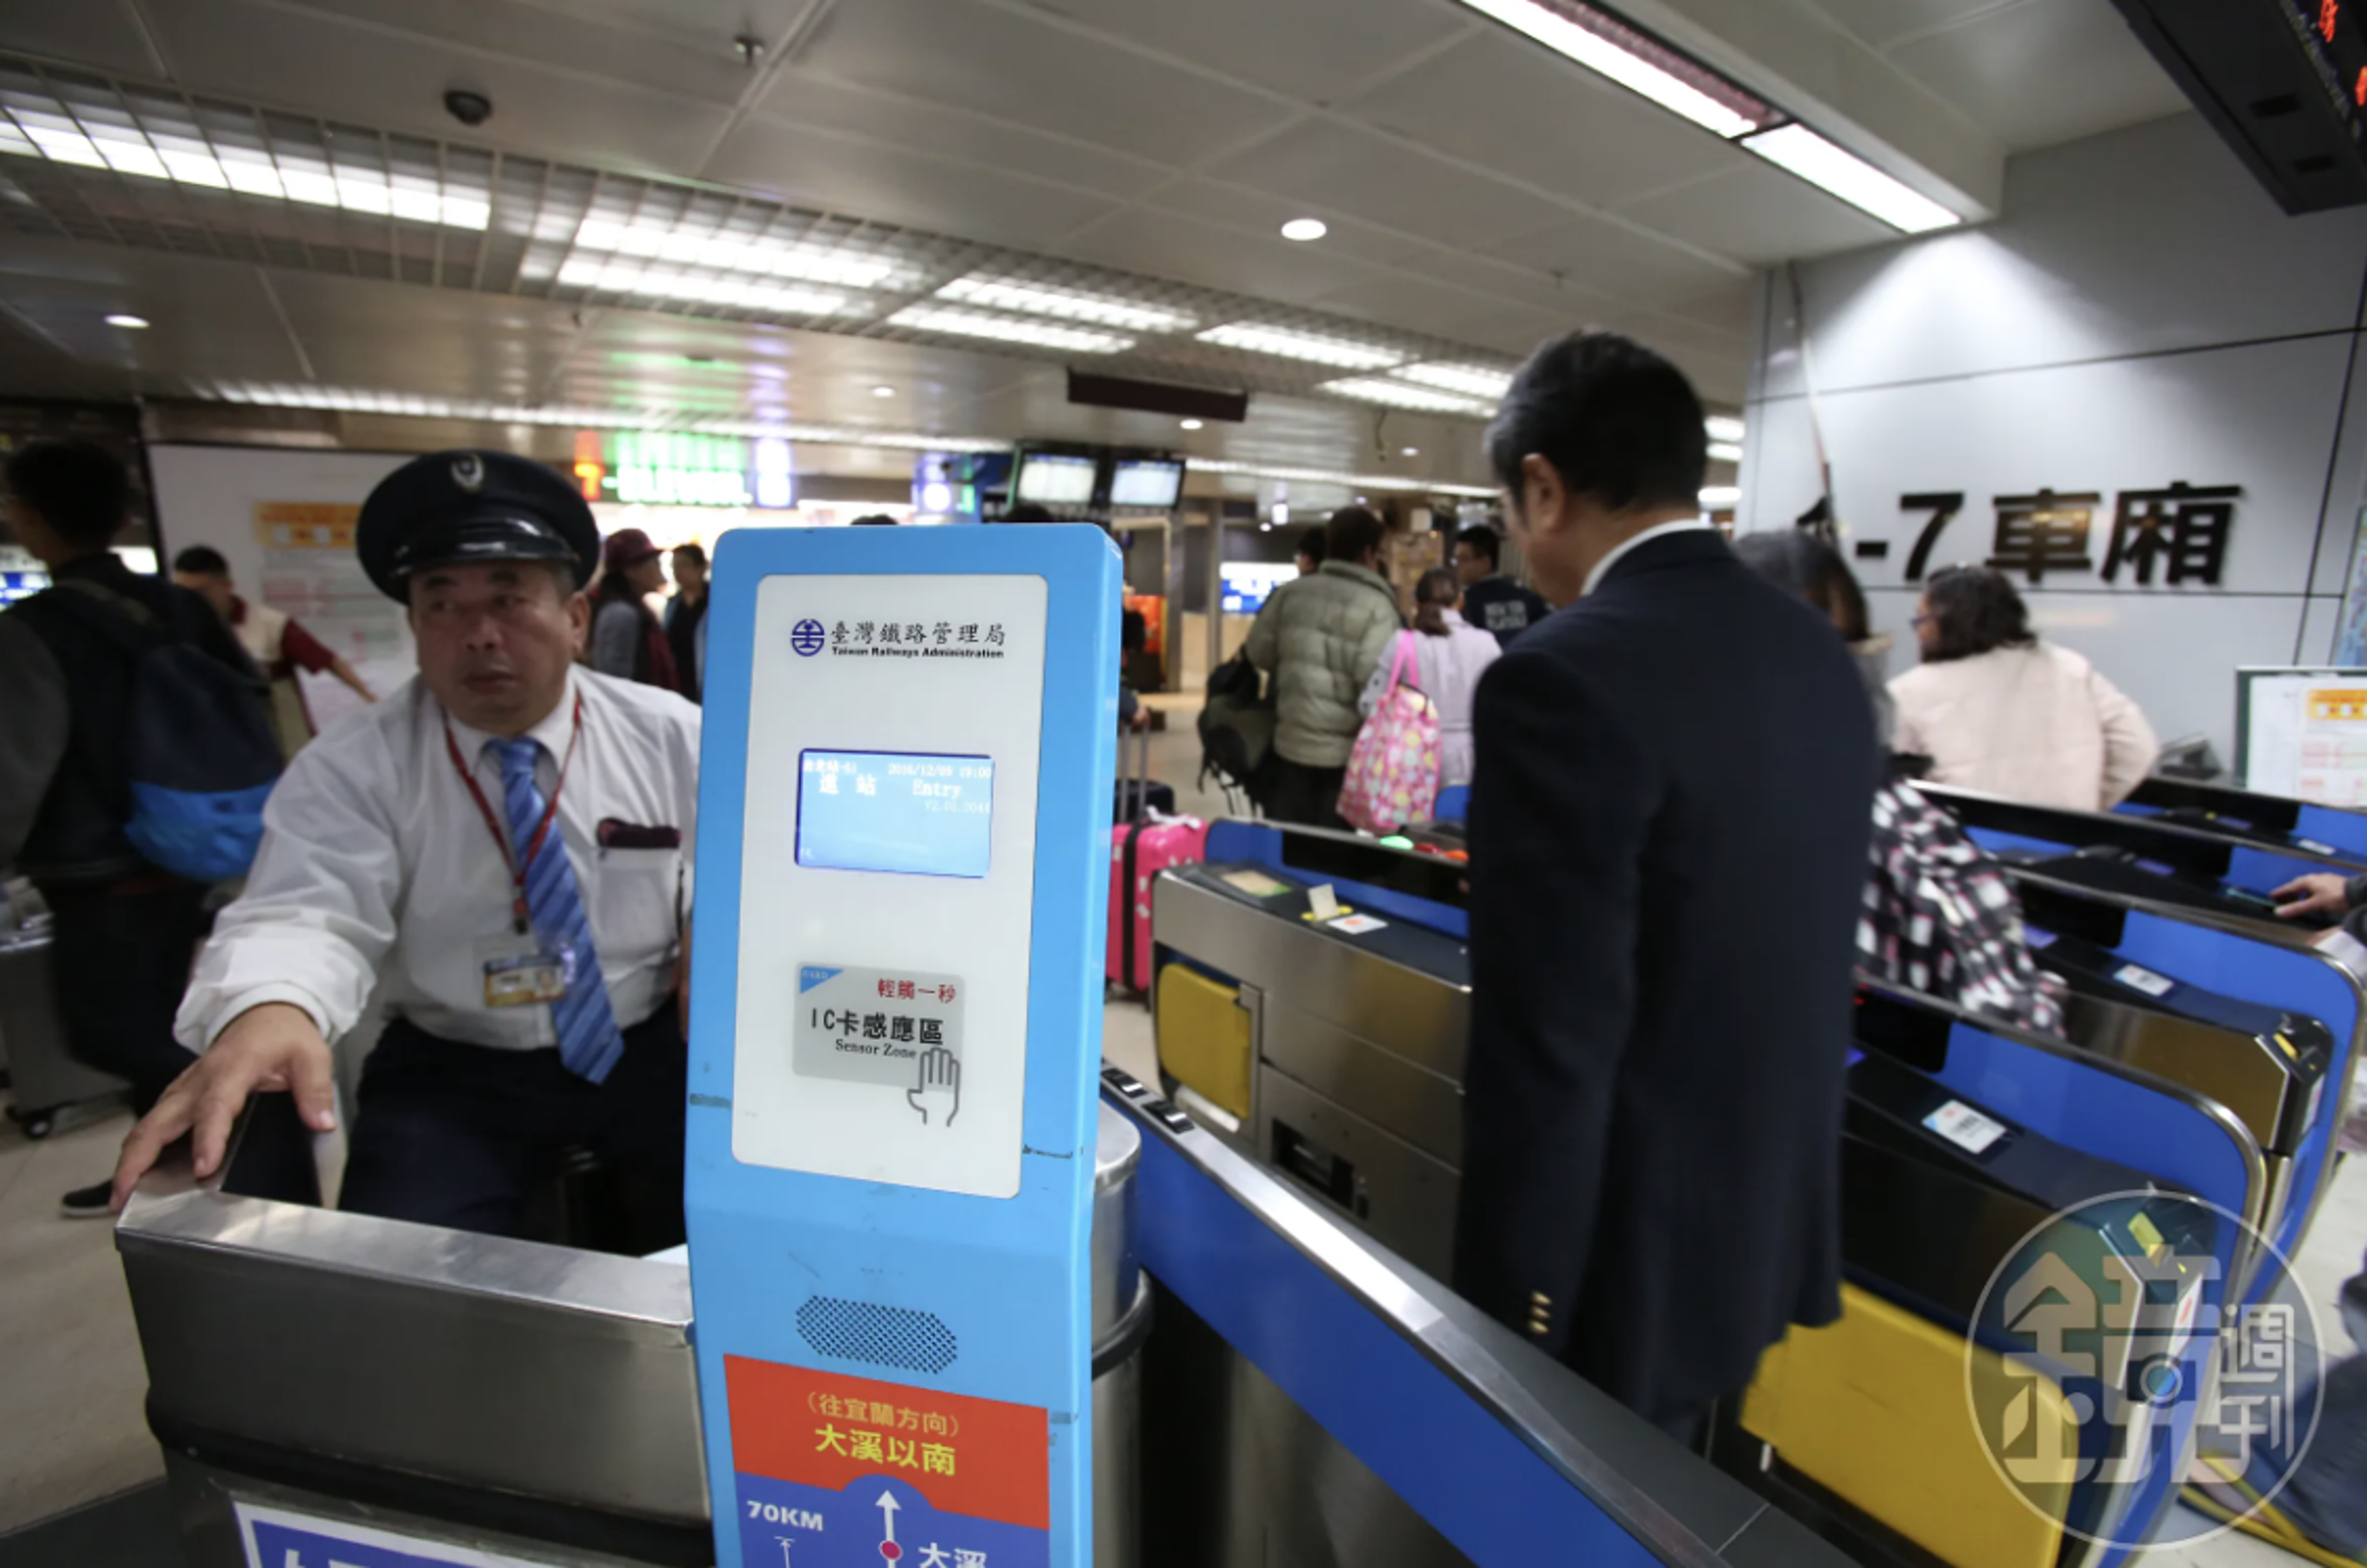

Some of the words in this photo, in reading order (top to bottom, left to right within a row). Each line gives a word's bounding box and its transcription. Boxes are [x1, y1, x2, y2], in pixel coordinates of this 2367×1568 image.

[830, 620, 1006, 646] 臺灣鐵路管理局
[832, 646, 868, 656] Taiwan
[872, 647, 918, 659] Railways
[922, 647, 1004, 659] Administration
[912, 778, 962, 800] Entry
[878, 978, 957, 1004] 輕觸一秒
[812, 1007, 944, 1045] IC卡感應區
[835, 1038, 880, 1055] Sensor
[884, 1043, 917, 1059] Zone
[815, 1423, 956, 1475] 大溪以南
[747, 1500, 825, 1531] 70KM
